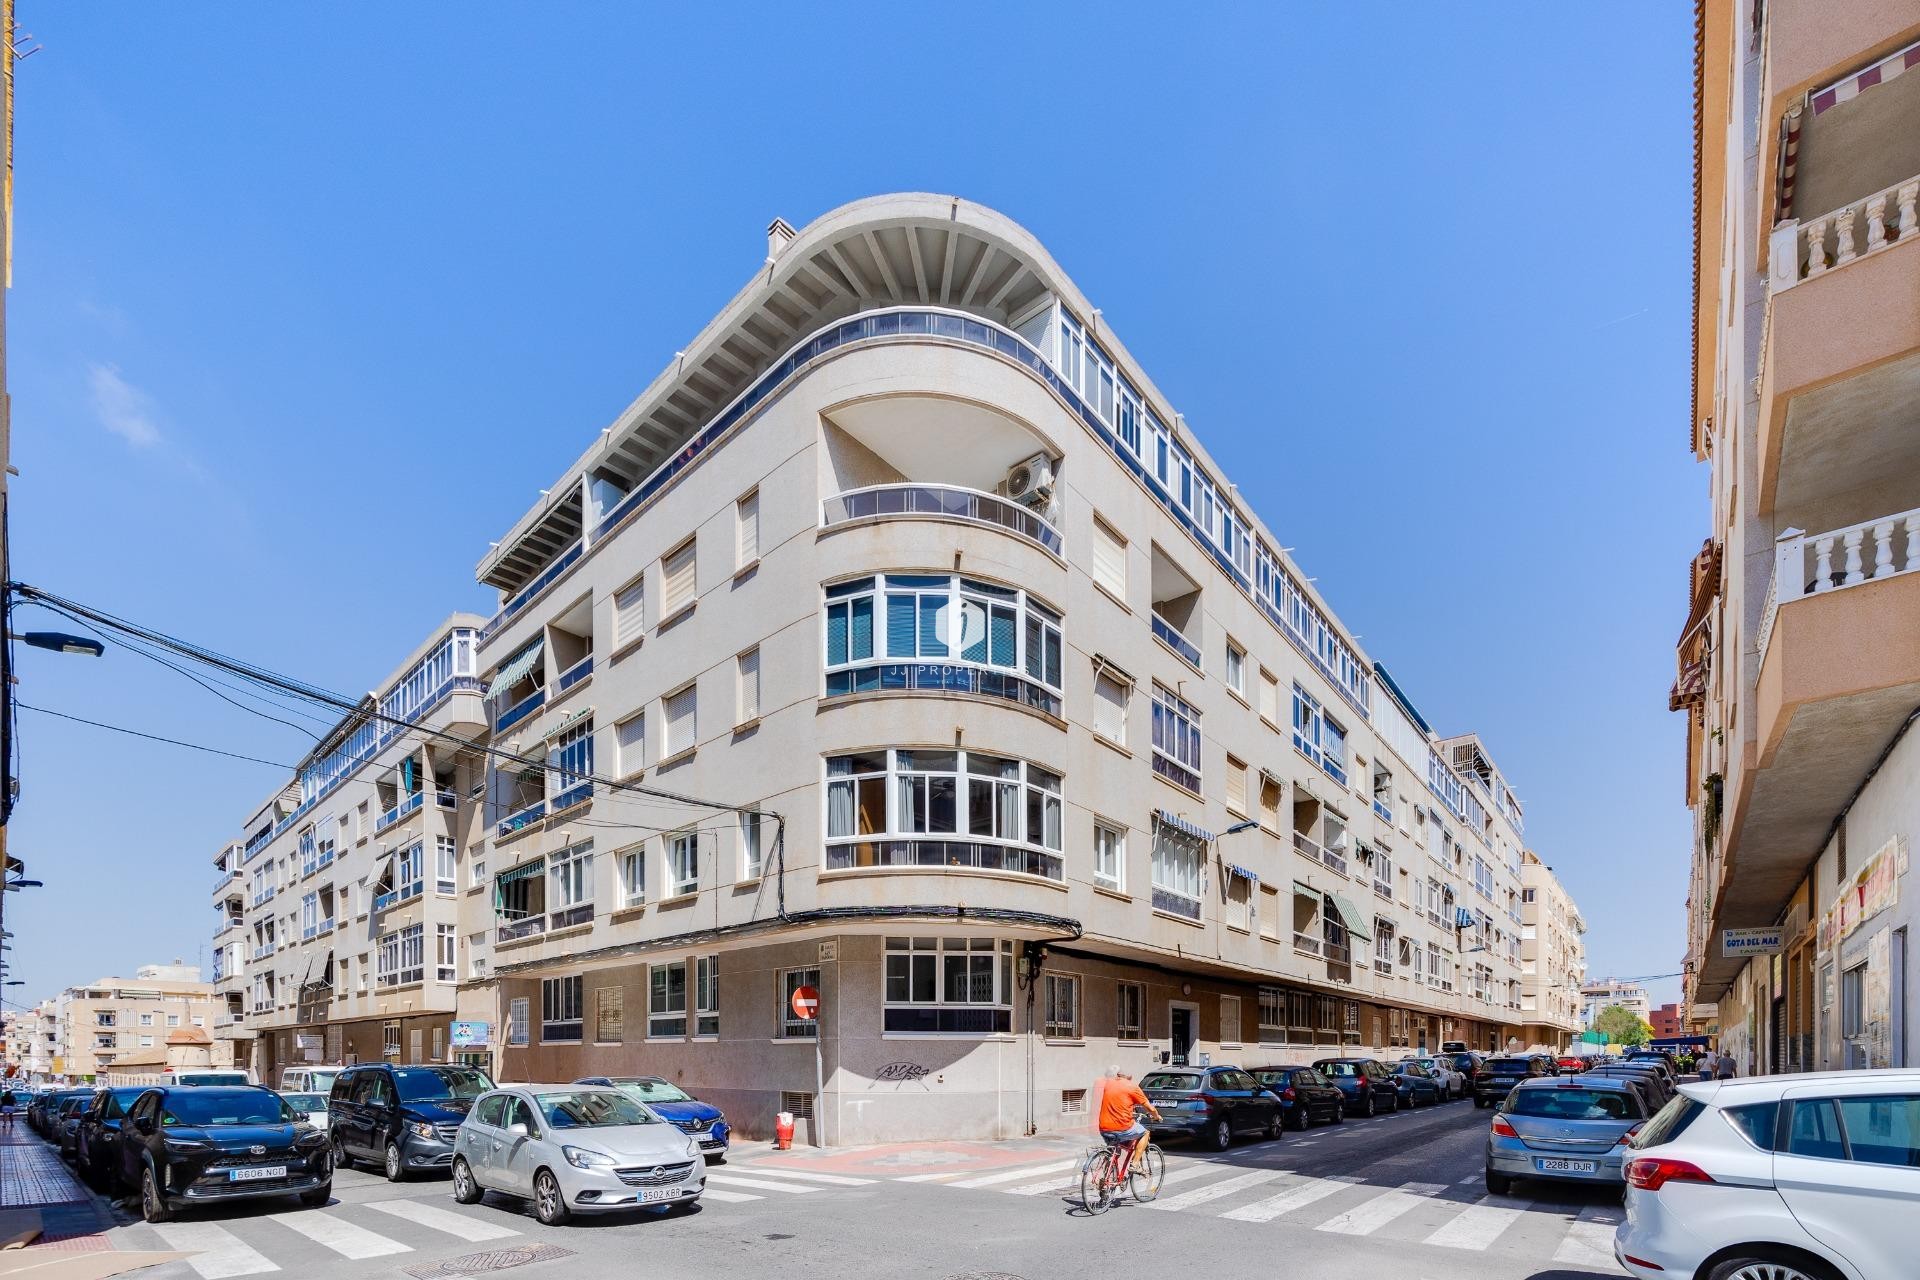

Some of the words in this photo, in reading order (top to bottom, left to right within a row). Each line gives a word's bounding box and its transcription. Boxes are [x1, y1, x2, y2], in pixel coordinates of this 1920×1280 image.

[1726, 938, 1745, 947] GOTA
[1746, 937, 1760, 946] DEL
[1761, 936, 1779, 945] MAR
[1545, 1160, 1569, 1170] 2288
[1573, 1162, 1592, 1171] DJR
[237, 1169, 263, 1179] 6606
[266, 1167, 285, 1177] NGD
[642, 1190, 664, 1200] 9502
[665, 1188, 681, 1198] KBR
